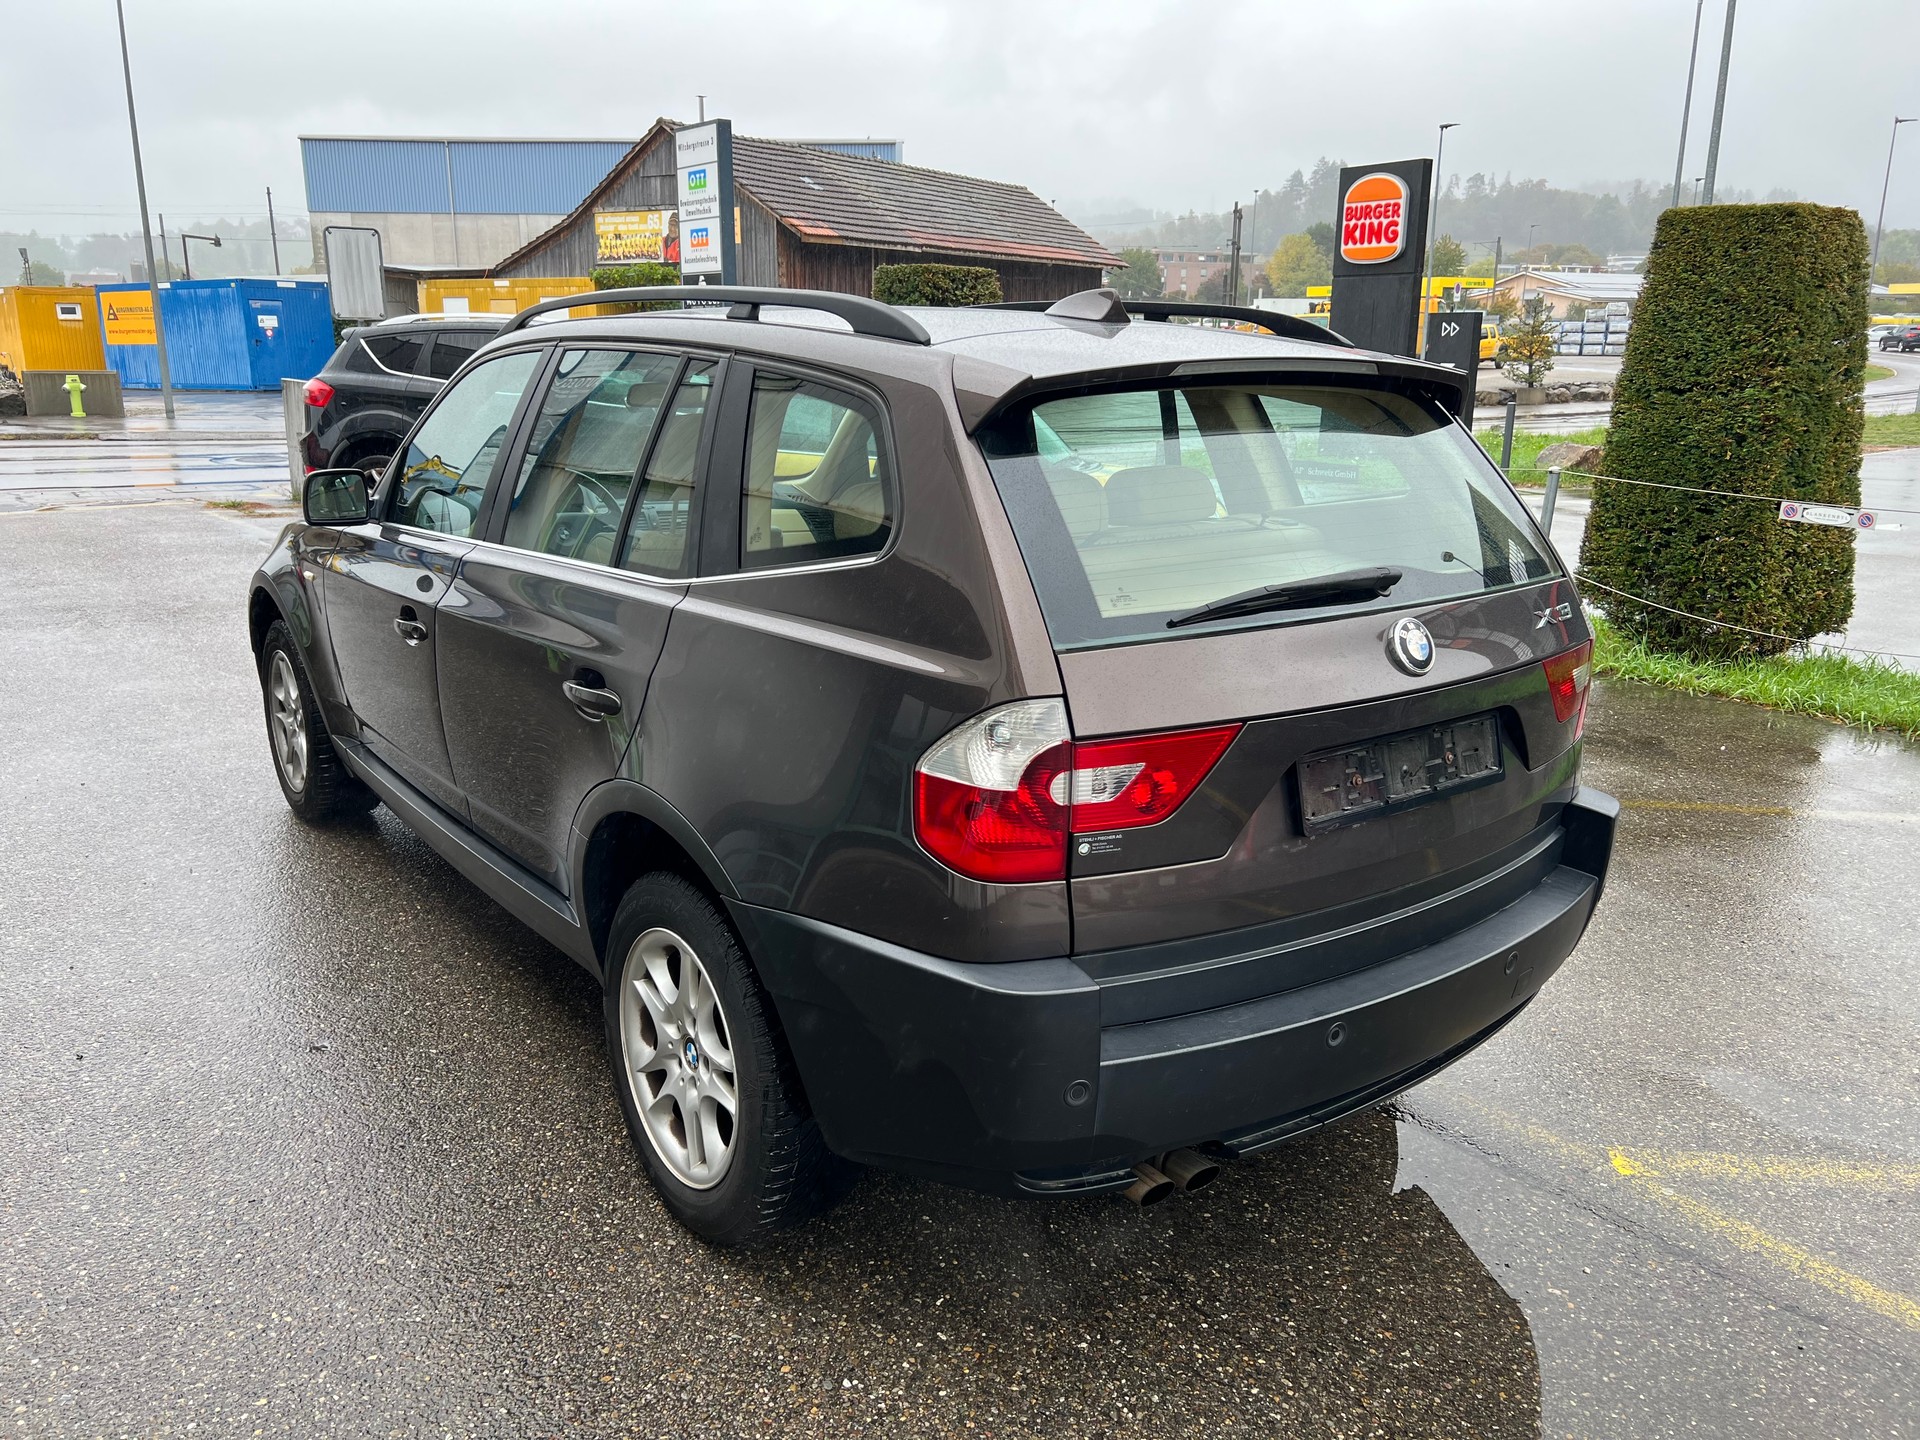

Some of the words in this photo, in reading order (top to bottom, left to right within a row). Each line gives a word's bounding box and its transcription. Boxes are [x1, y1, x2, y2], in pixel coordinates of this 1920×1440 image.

[710, 137, 714, 145] 3
[689, 172, 705, 187] OTT
[1345, 202, 1401, 222] BURGER
[691, 231, 707, 245] OTT
[1343, 220, 1399, 246] KING
[1334, 469, 1356, 479] GmbH
[1533, 602, 1573, 630] X3
